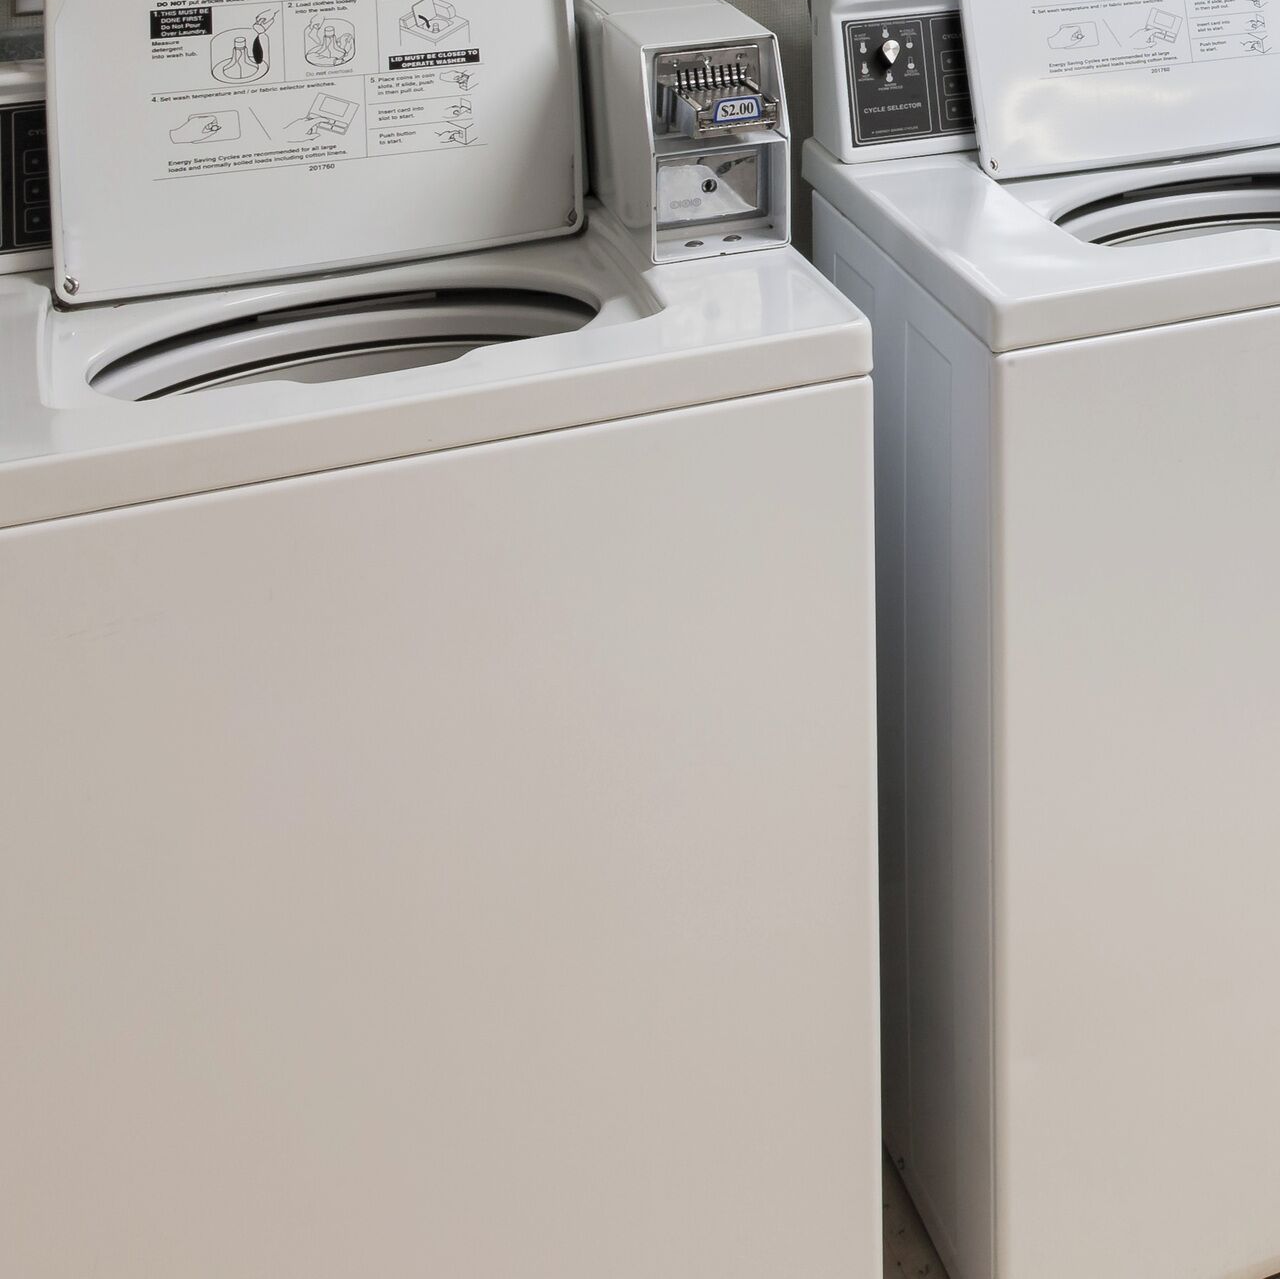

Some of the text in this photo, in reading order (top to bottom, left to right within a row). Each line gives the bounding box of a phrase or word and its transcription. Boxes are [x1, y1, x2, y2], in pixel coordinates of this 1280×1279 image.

[402, 60, 434, 68] OPERATE
[721, 101, 754, 117] $2.00
[864, 102, 921, 114] CYCLE SELECTOR
[168, 159, 192, 167] Energy
[253, 148, 300, 157] recommended
[309, 163, 335, 171] 201760
